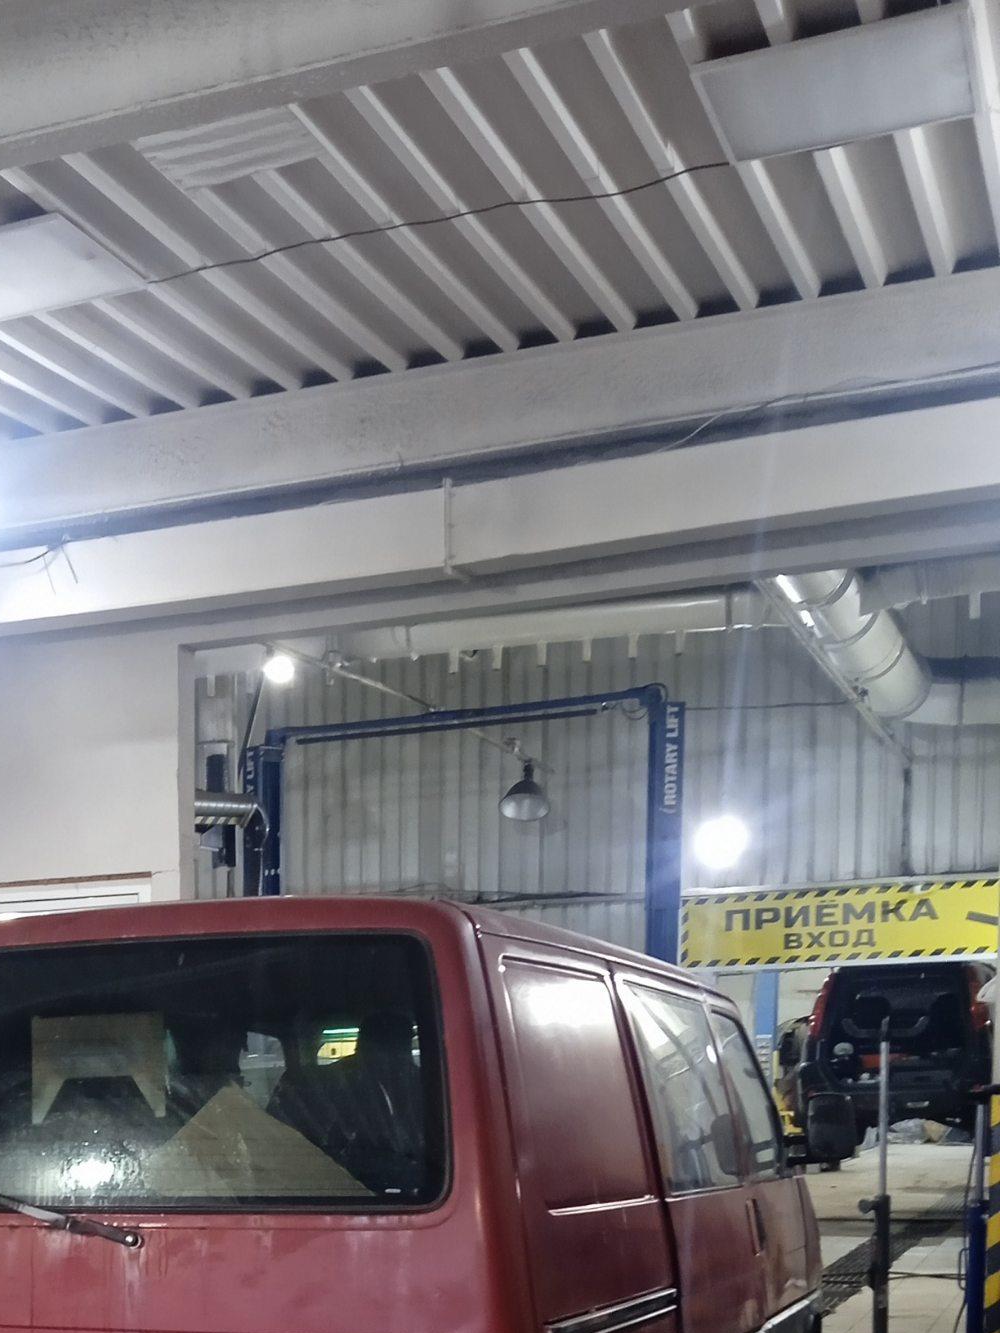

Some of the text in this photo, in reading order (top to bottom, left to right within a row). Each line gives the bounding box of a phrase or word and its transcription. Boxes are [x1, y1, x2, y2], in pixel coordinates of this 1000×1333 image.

[663, 704, 680, 806] ROTARY LIFT
[724, 897, 939, 932] ПРИЁМКА
[783, 929, 877, 950] ВХОД
